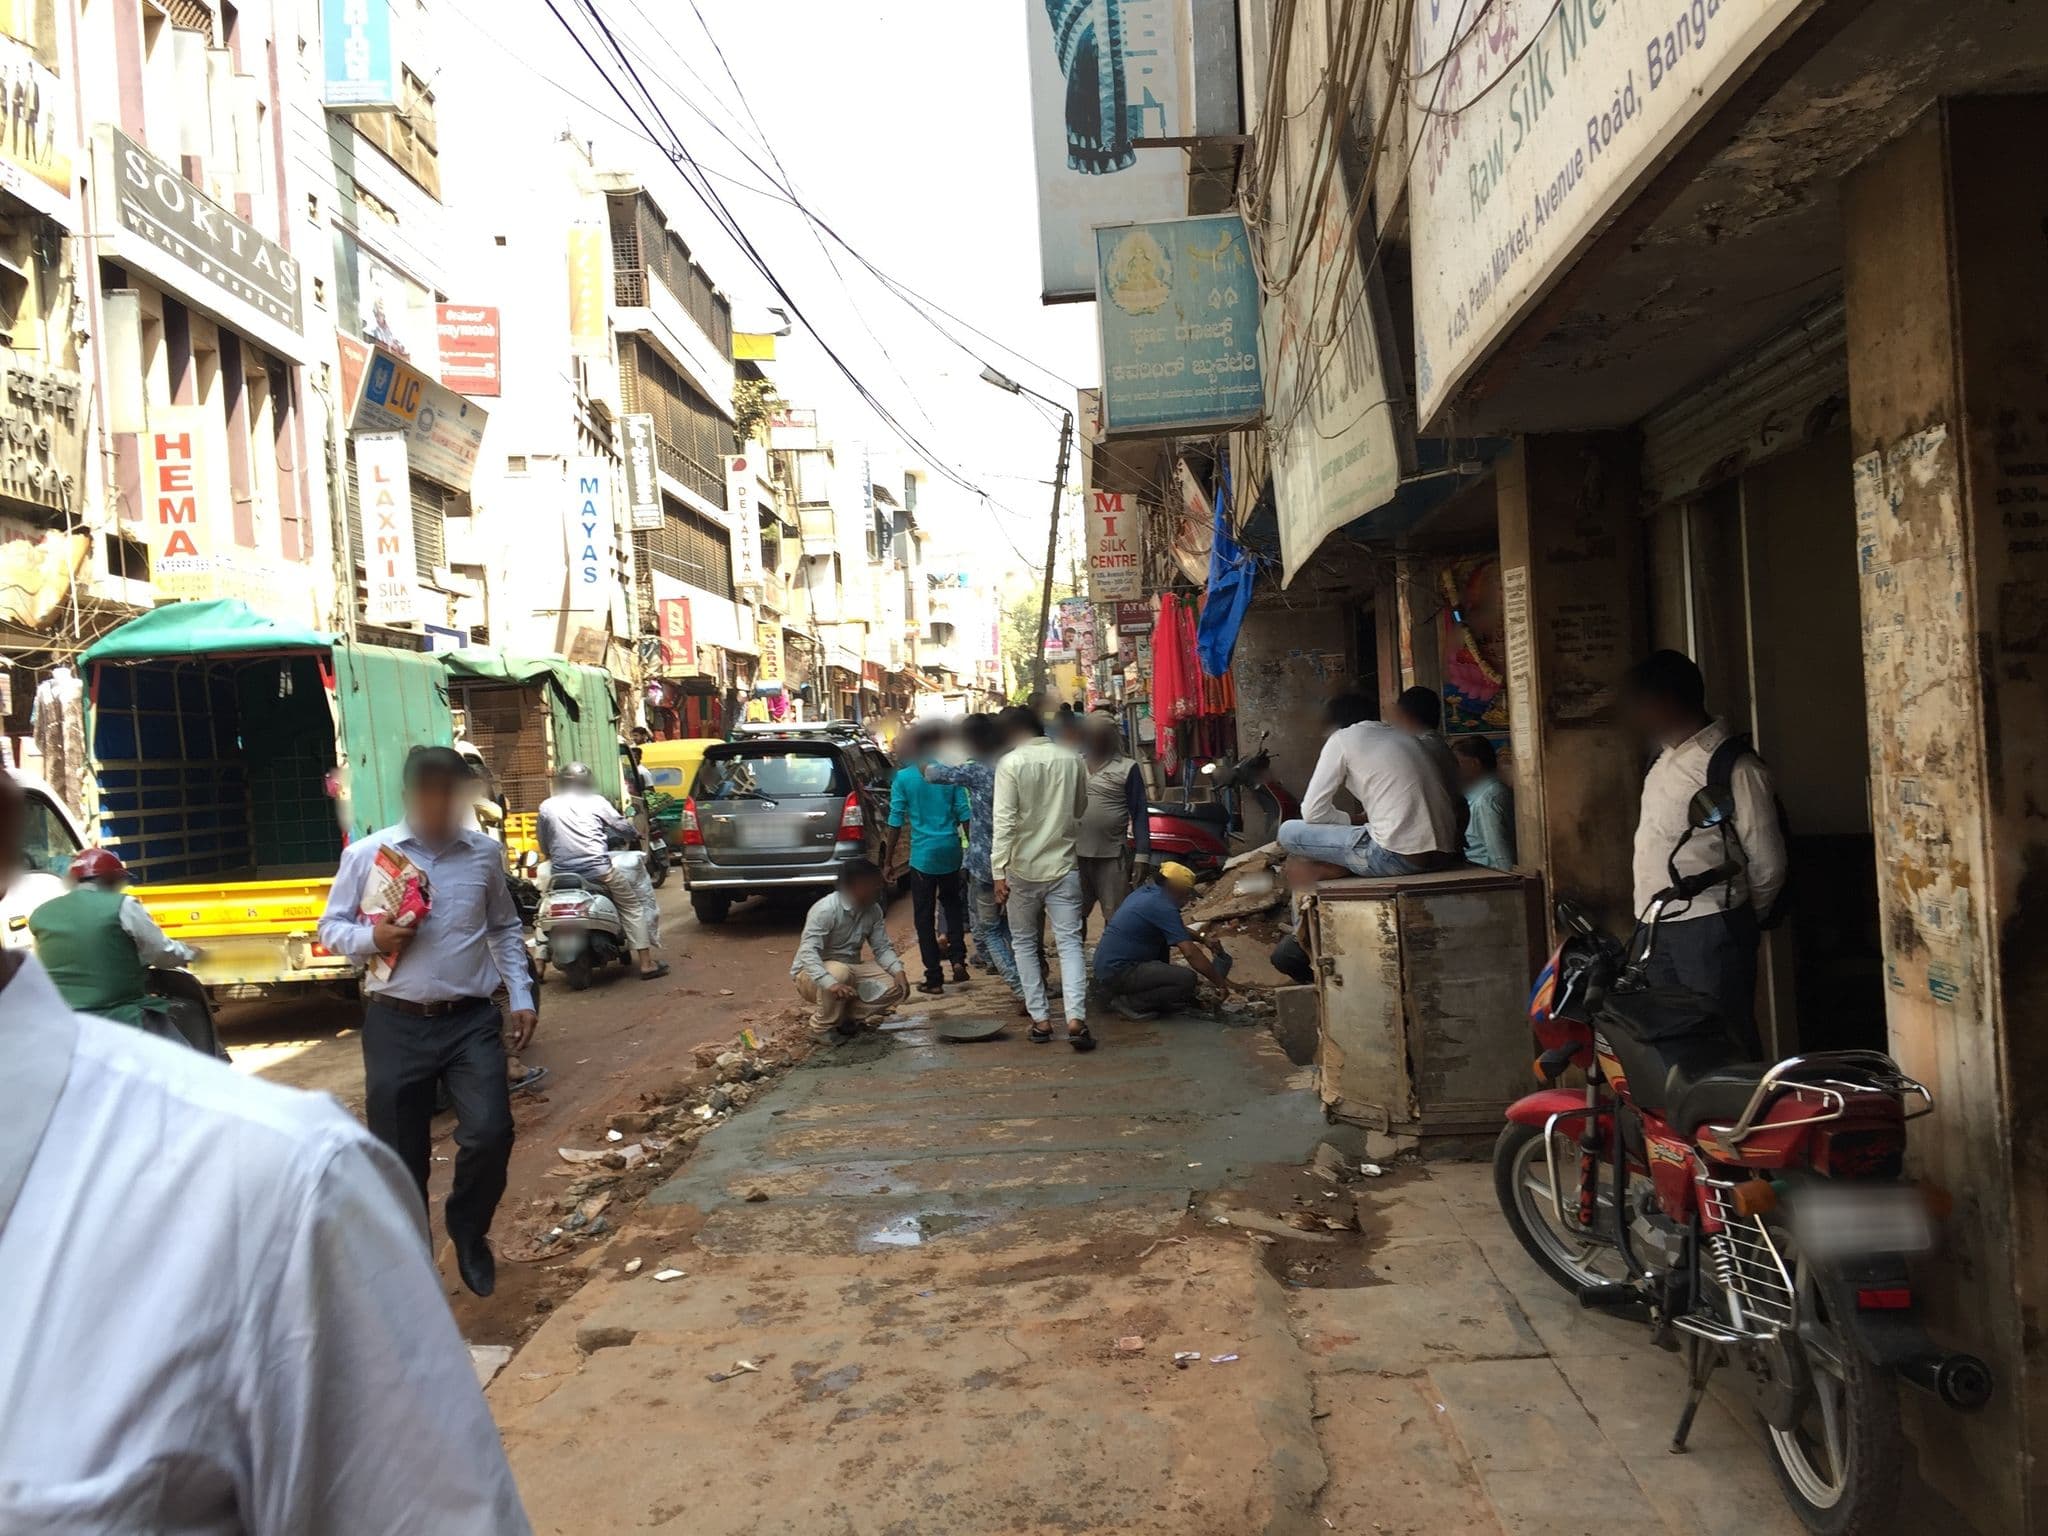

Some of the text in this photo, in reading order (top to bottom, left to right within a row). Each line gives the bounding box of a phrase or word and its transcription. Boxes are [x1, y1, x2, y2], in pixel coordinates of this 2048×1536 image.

[1469, 0, 1617, 223] Raw Silk Me
[1534, 147, 1583, 234] Avenue
[1587, 69, 1642, 163] Road,
[125, 150, 297, 293] SOKTAS
[127, 211, 185, 258] WEAR
[390, 372, 420, 414] LIC
[155, 433, 199, 557] HEMA
[373, 464, 400, 577] LAXMI
[580, 478, 599, 583] MAYAS
[738, 486, 751, 573] DEVATHA
[1091, 554, 1137, 569] CENTRE
[1100, 539, 1127, 552] SILK
[379, 583, 408, 598] SILK
[282, 905, 313, 917] HORN
